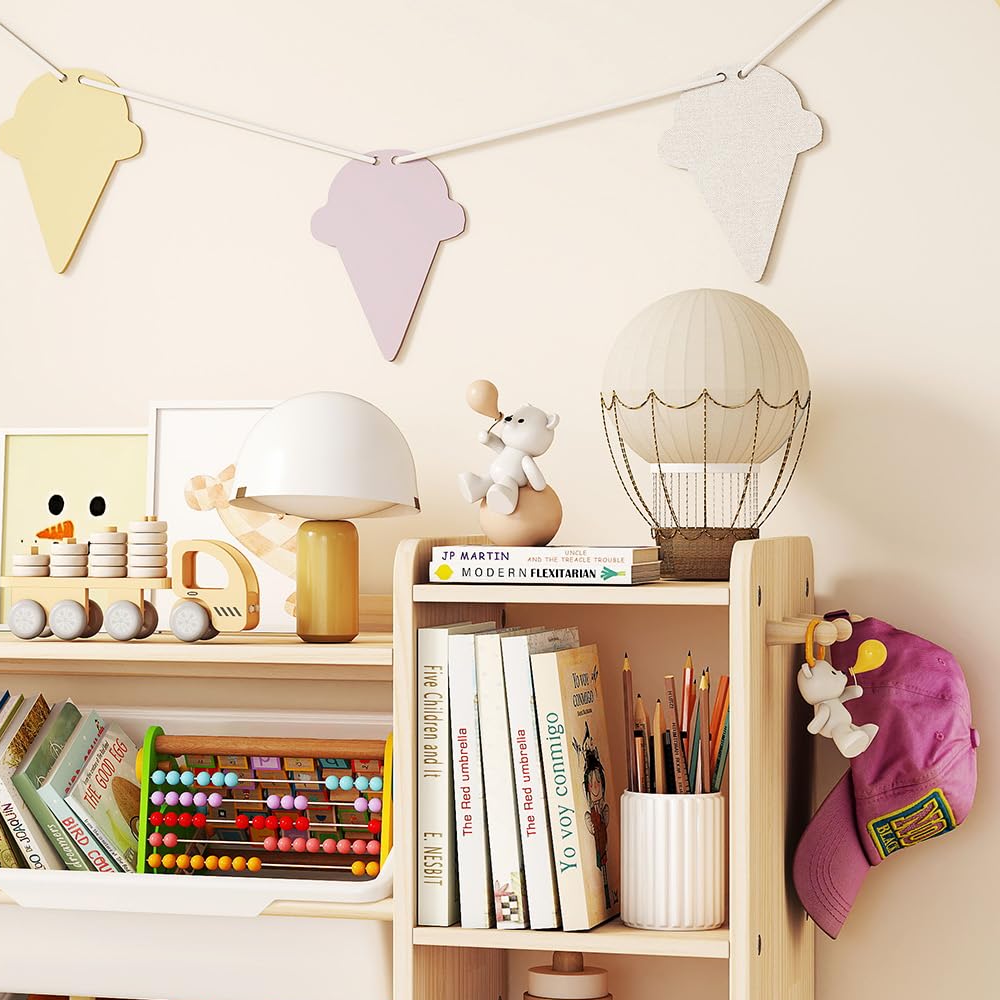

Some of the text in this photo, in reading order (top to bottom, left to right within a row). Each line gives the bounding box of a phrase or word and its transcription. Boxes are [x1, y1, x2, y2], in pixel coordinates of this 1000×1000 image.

[441, 551, 509, 561] JP MARTIN
[462, 567, 596, 579] MODERN FLEXITARIAN
[423, 665, 443, 778] Five Children and It
[83, 784, 102, 810] THE
[94, 758, 115, 789] GOOD
[109, 737, 128, 763] EGG
[458, 727, 473, 837] The Red umbrella
[517, 728, 537, 838] The Red umbrella
[546, 712, 578, 873] Yo voy conmigo
[1, 802, 30, 843] JOAQUÍN
[61, 816, 89, 846] BIRD
[87, 849, 115, 873] COU
[423, 832, 443, 886] E. NESBIT
